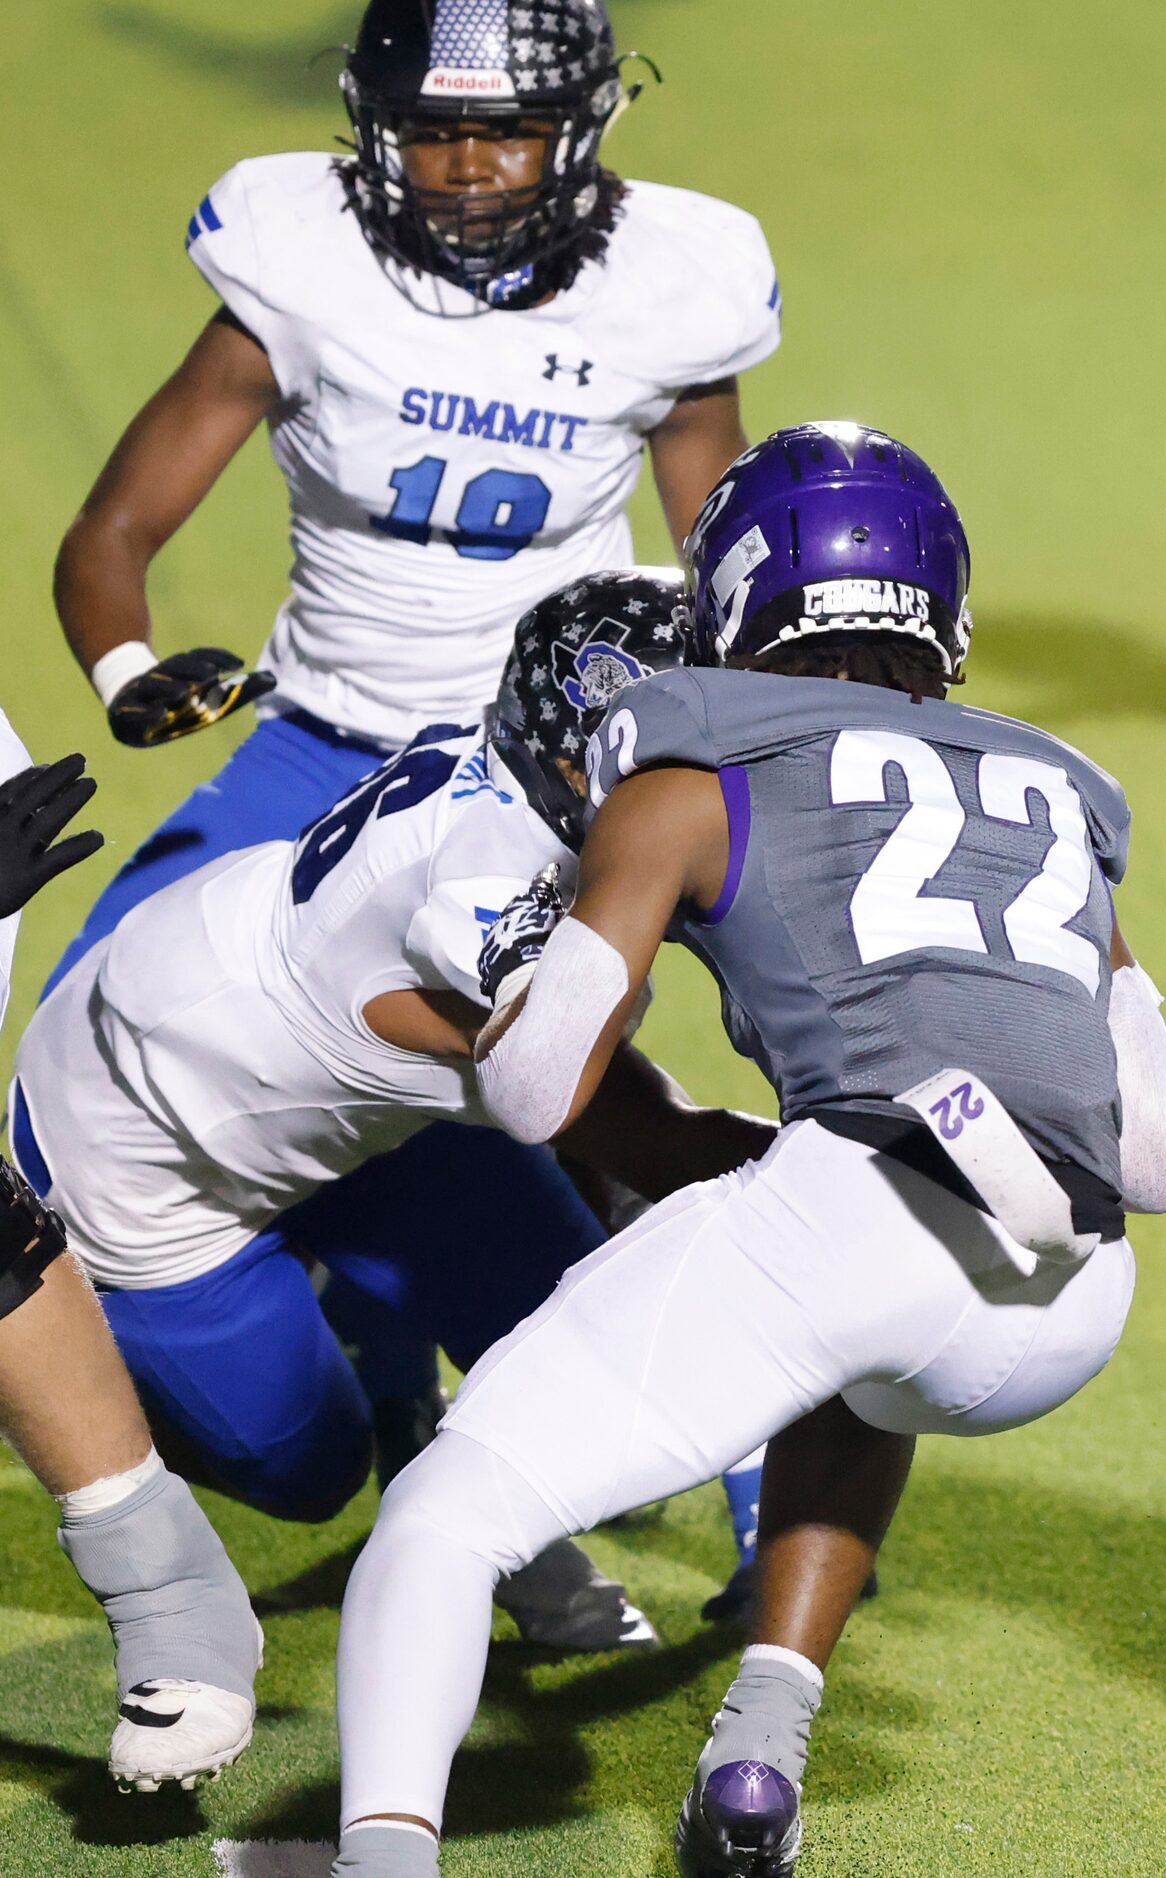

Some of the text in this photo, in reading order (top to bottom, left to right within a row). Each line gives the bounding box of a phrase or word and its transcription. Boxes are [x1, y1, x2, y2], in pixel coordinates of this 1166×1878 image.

[433, 74, 502, 89] Riddell
[399, 387, 589, 450] SUMMIT
[802, 579, 930, 622] COUGARS
[827, 728, 1101, 1001] 22
[928, 1081, 985, 1140] 22
